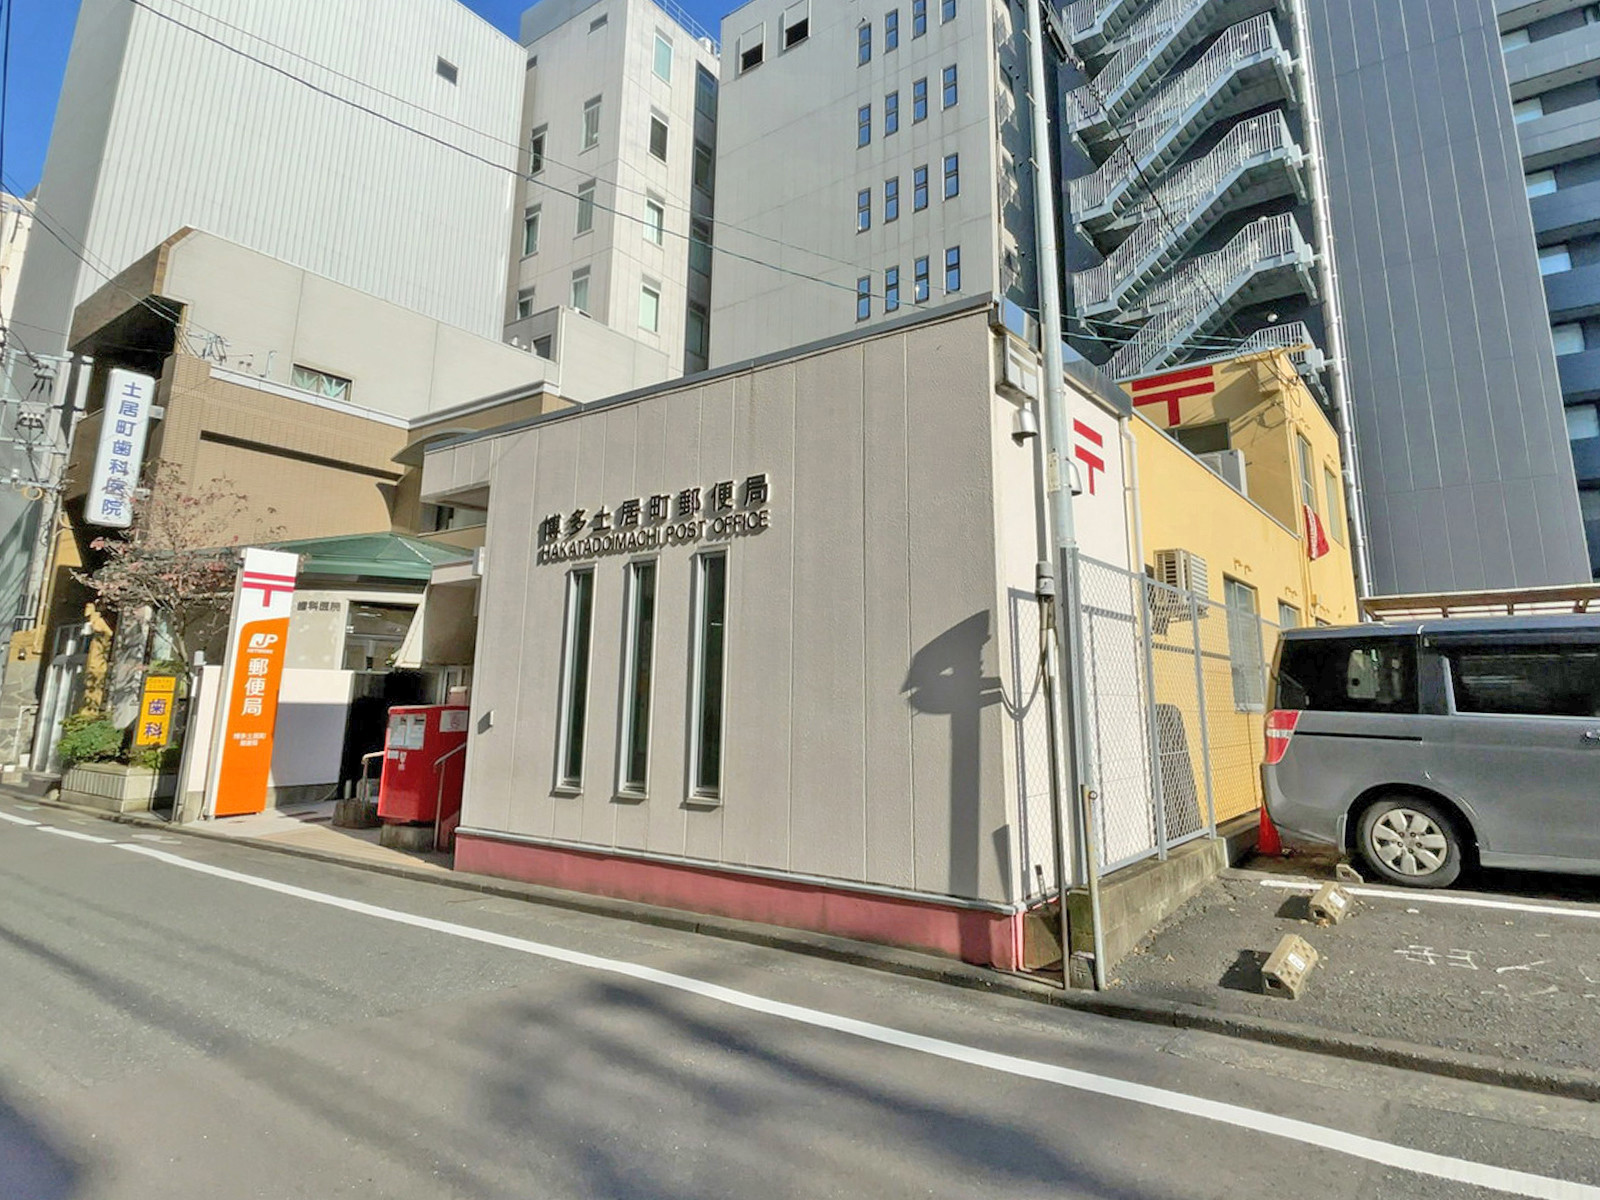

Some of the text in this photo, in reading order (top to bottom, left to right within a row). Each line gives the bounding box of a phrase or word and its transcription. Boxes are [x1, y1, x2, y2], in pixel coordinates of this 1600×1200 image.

[101, 382, 142, 516] 土居町歯科医院
[541, 509, 769, 562] HAKATADOIMACHI POST OFFICE
[542, 473, 769, 542] 博多土居町郵便局
[241, 658, 269, 716] 郵便局
[144, 698, 167, 739] 歯科
